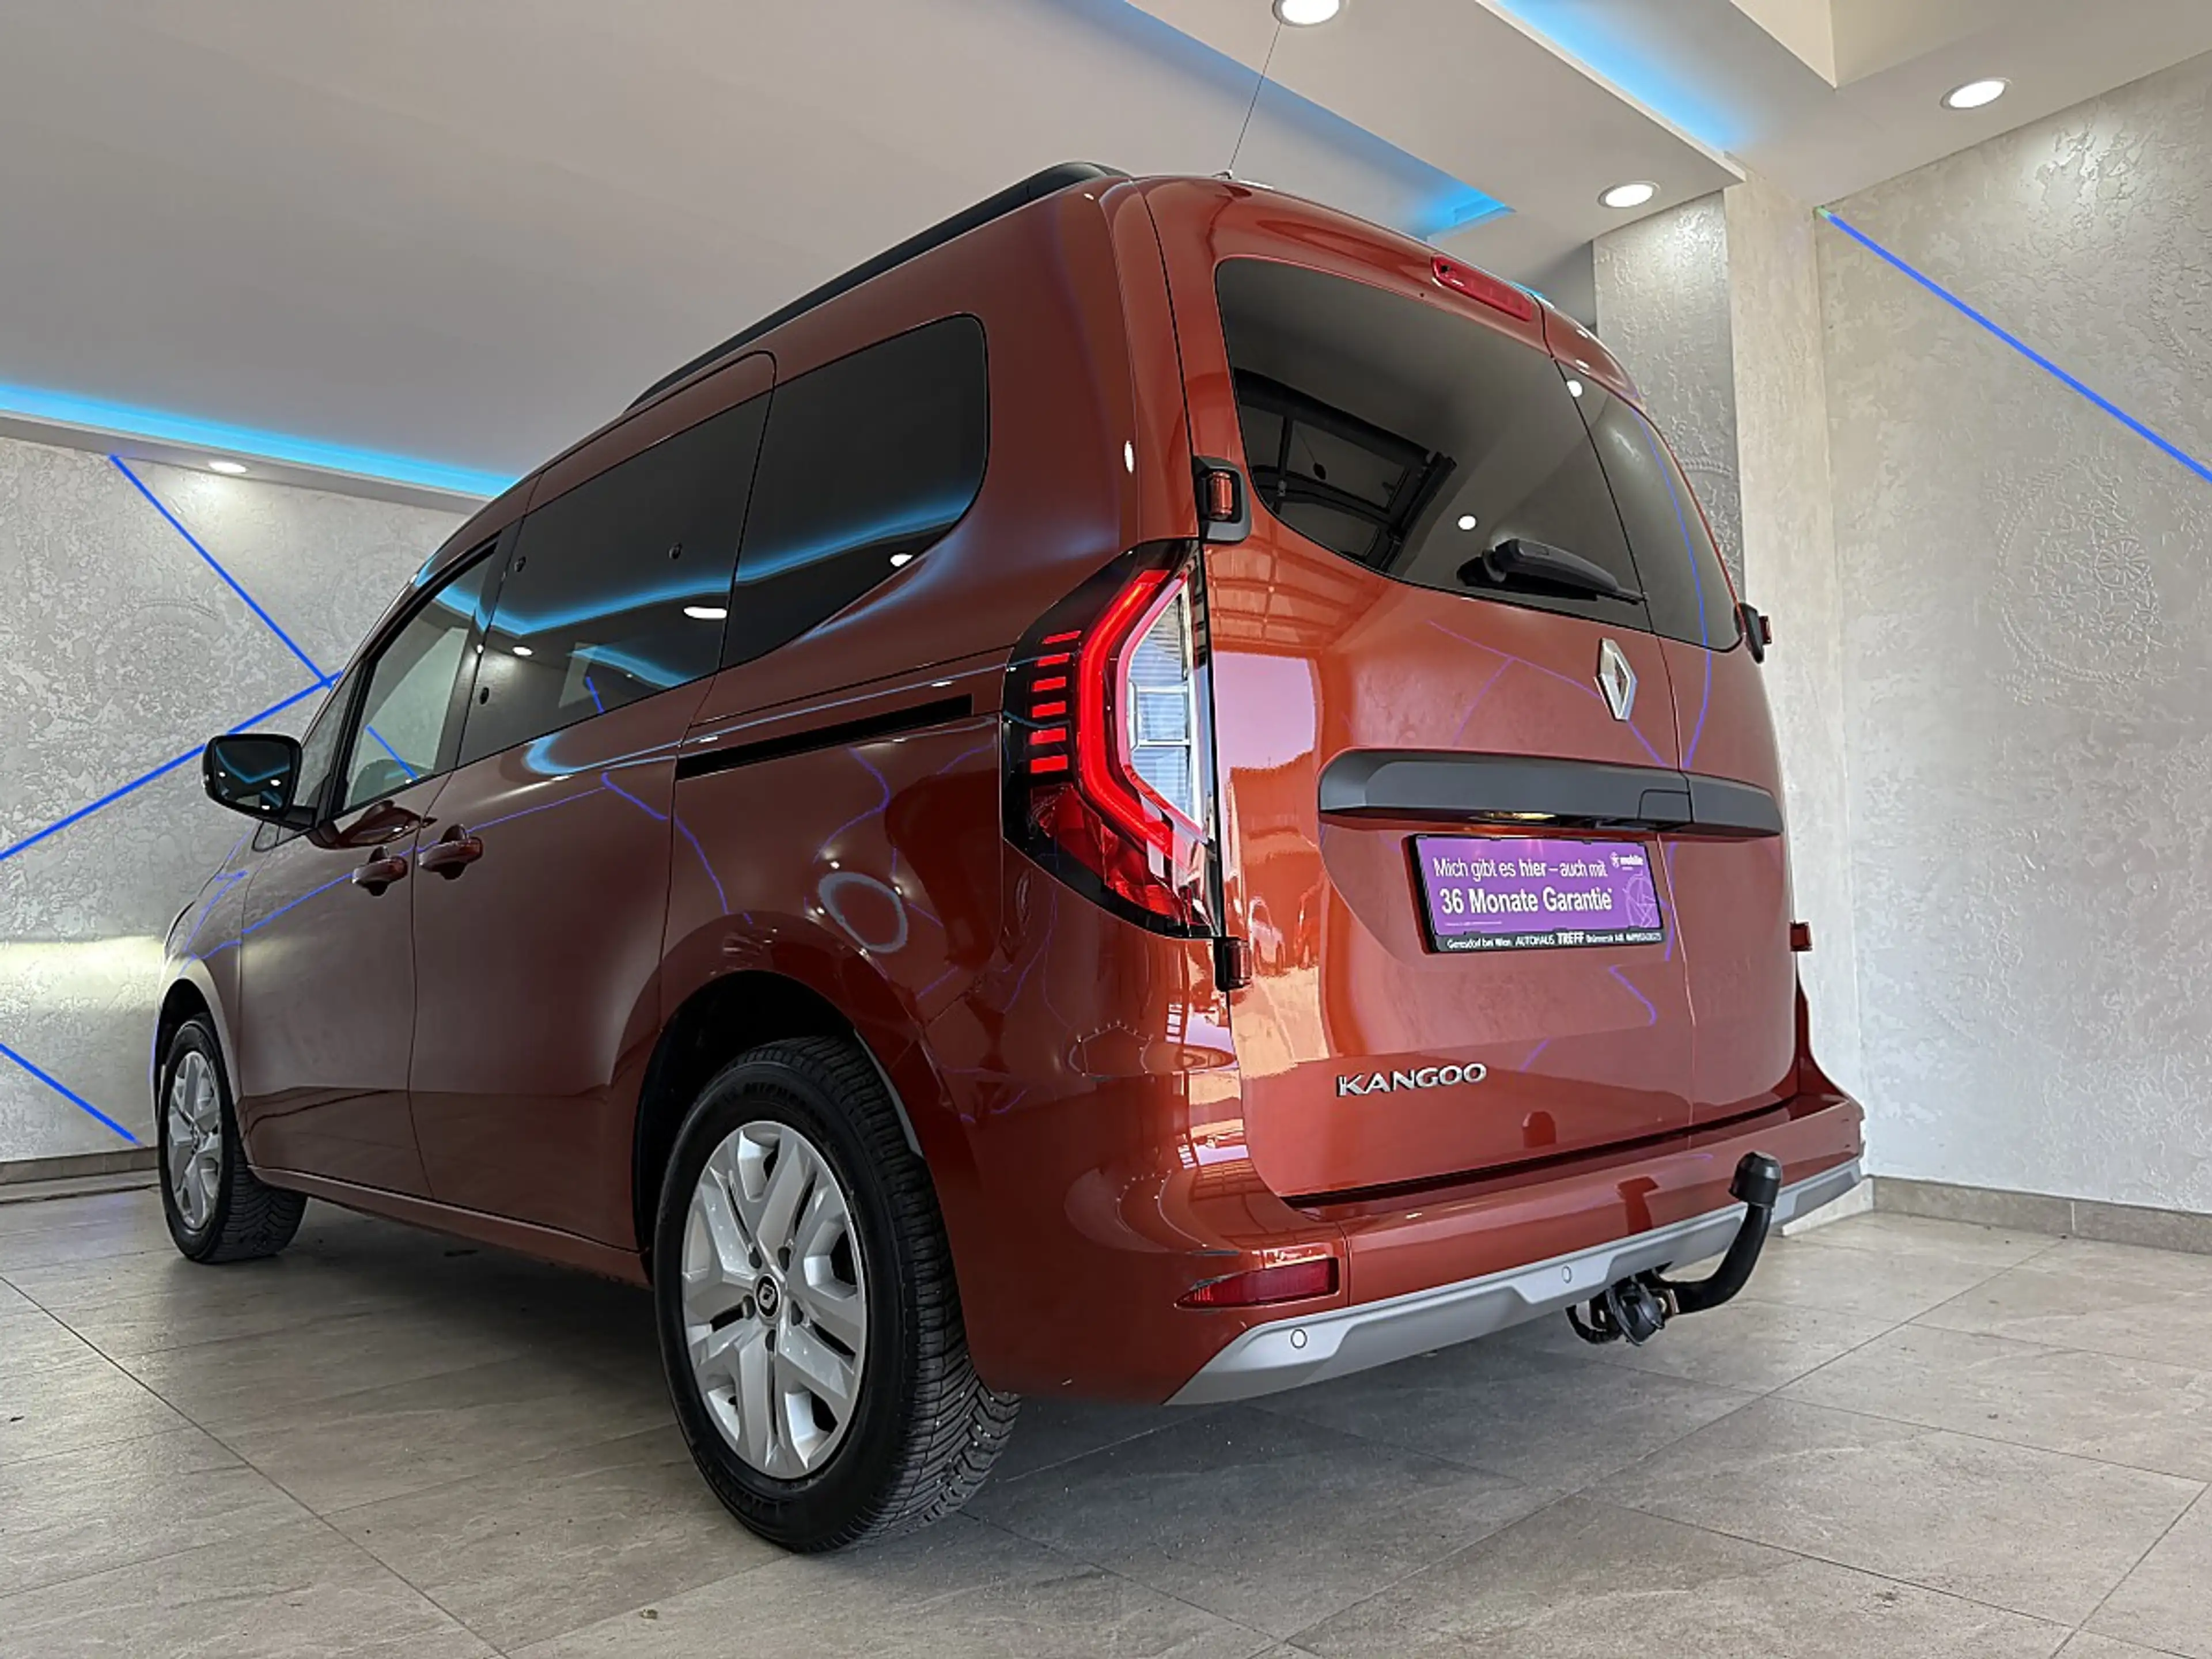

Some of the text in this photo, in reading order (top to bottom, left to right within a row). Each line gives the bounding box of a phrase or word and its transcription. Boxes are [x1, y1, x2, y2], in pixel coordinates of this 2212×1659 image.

[1433, 857, 1468, 877] Mich
[1471, 858, 1498, 882] gibt
[1499, 862, 1516, 877] es
[1518, 858, 1547, 877] hier
[1559, 859, 1588, 877] auch
[1589, 859, 1608, 877] mit
[1440, 888, 1464, 914] 36
[1468, 888, 1539, 914] Monate
[1556, 931, 1584, 945] TREFF
[1336, 1063, 1487, 1097] KANGOO
